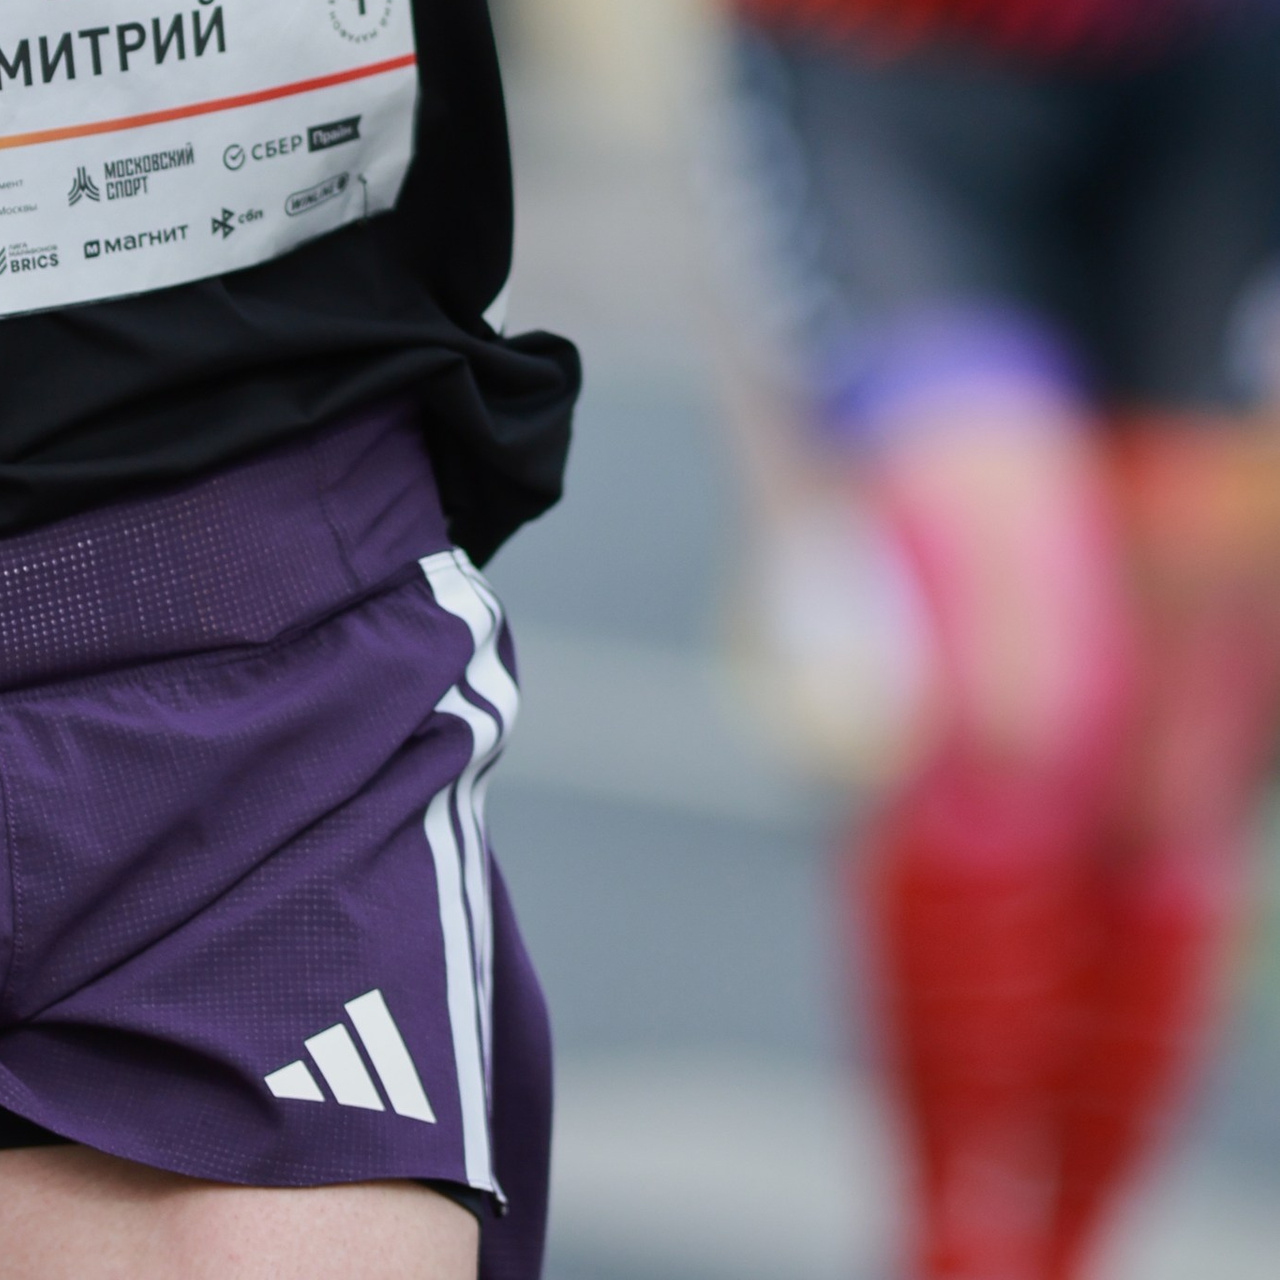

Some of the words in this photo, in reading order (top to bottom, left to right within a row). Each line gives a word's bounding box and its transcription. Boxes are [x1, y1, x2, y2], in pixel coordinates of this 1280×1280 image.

[251, 134, 303, 161] СБЕР
[104, 142, 195, 180] МОСКОВСКИЙ
[106, 175, 148, 201] СПОРТ
[238, 209, 263, 224] сбп
[10, 253, 59, 274] BRICS
